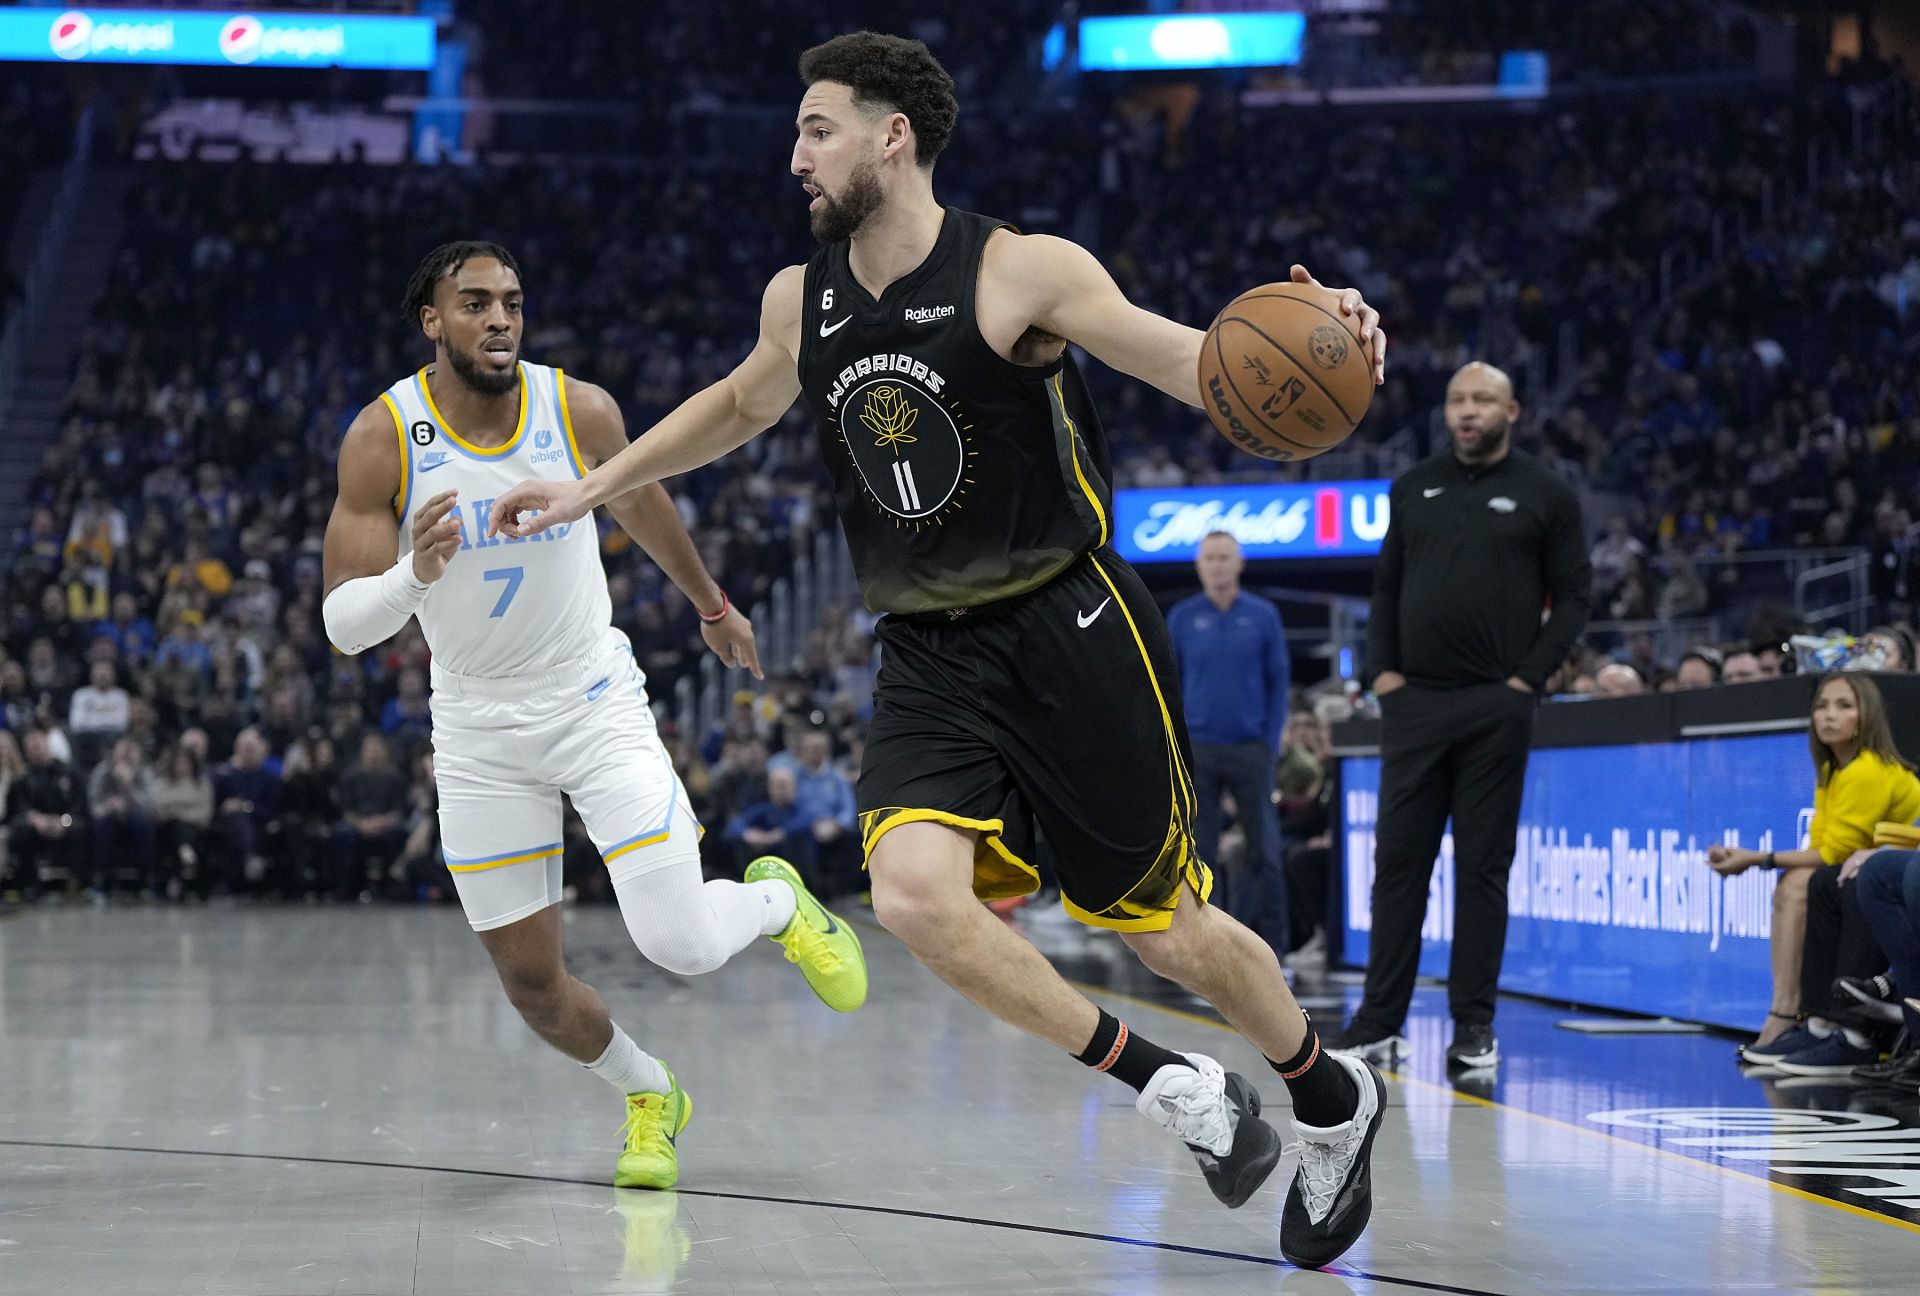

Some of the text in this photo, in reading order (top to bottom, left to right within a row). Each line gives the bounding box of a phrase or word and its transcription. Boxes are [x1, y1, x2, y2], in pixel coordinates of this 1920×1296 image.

[821, 288, 834, 310] 6
[905, 305, 955, 324] Rakuten
[826, 354, 946, 408] WARRIORS
[416, 424, 431, 443] 6
[530, 449, 564, 464] bibigo
[892, 459, 921, 511] 11
[483, 566, 524, 618] 7
